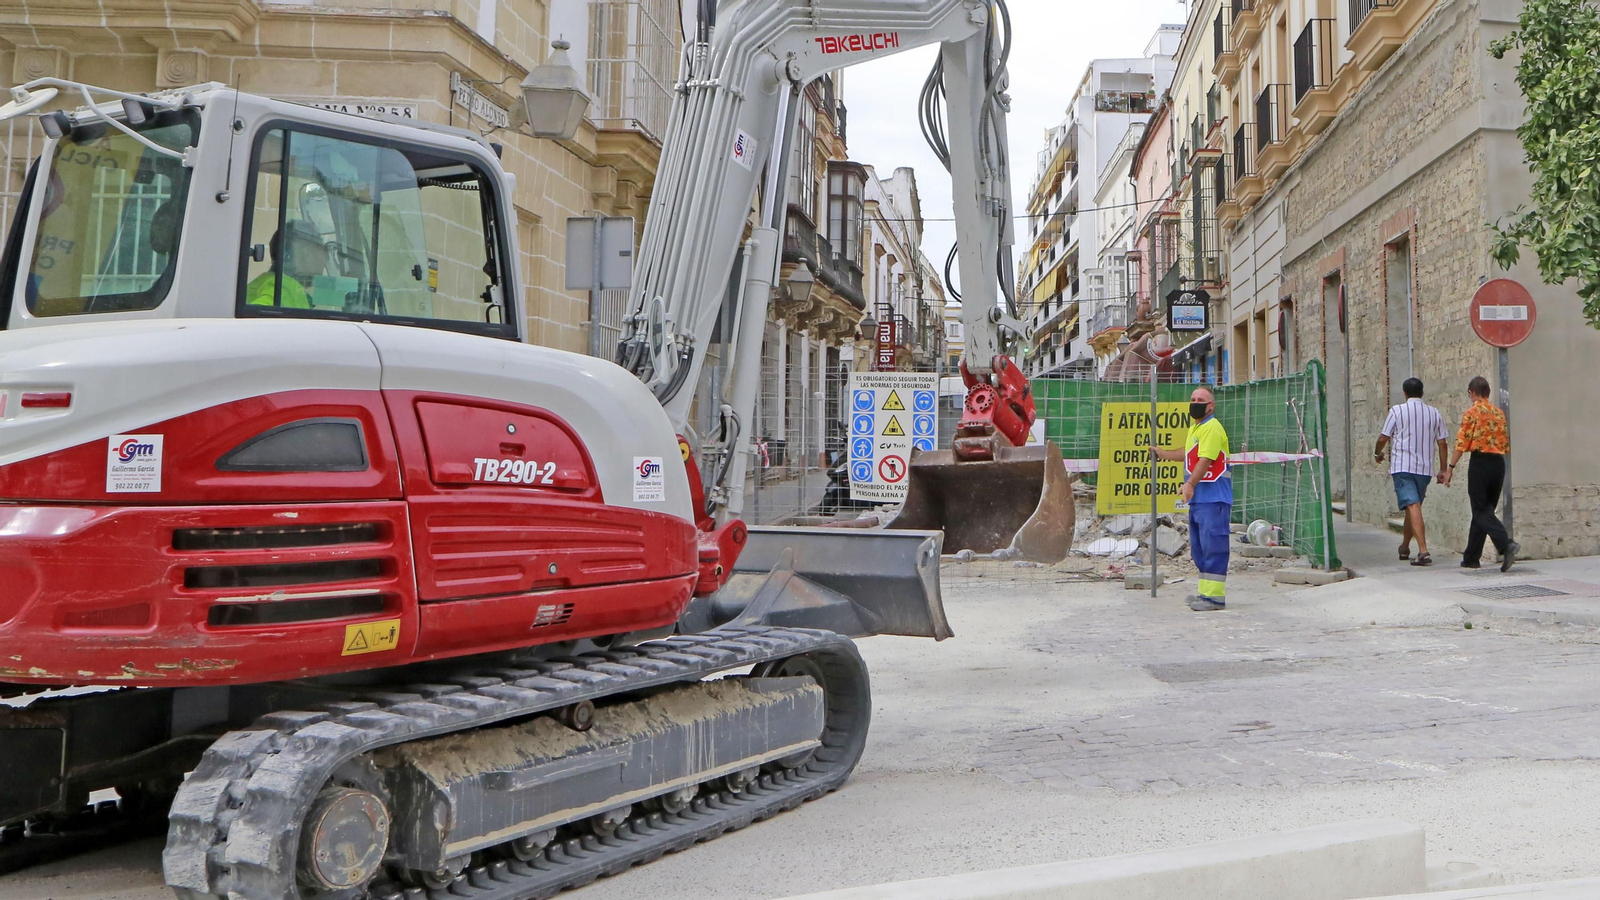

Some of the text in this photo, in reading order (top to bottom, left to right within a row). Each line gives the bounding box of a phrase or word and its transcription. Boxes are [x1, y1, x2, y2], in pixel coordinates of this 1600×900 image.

[480, 102, 506, 126] ALONSO
[880, 324, 894, 363] manila
[879, 442, 892, 450] CV
[1134, 433, 1172, 446] CALE
[474, 457, 557, 485] TB290-2
[1125, 463, 1178, 480] TRÁICO
[853, 482, 885, 490] PROHIBIDO
[1114, 483, 1140, 497] POR
[855, 490, 880, 498] PERSONA
